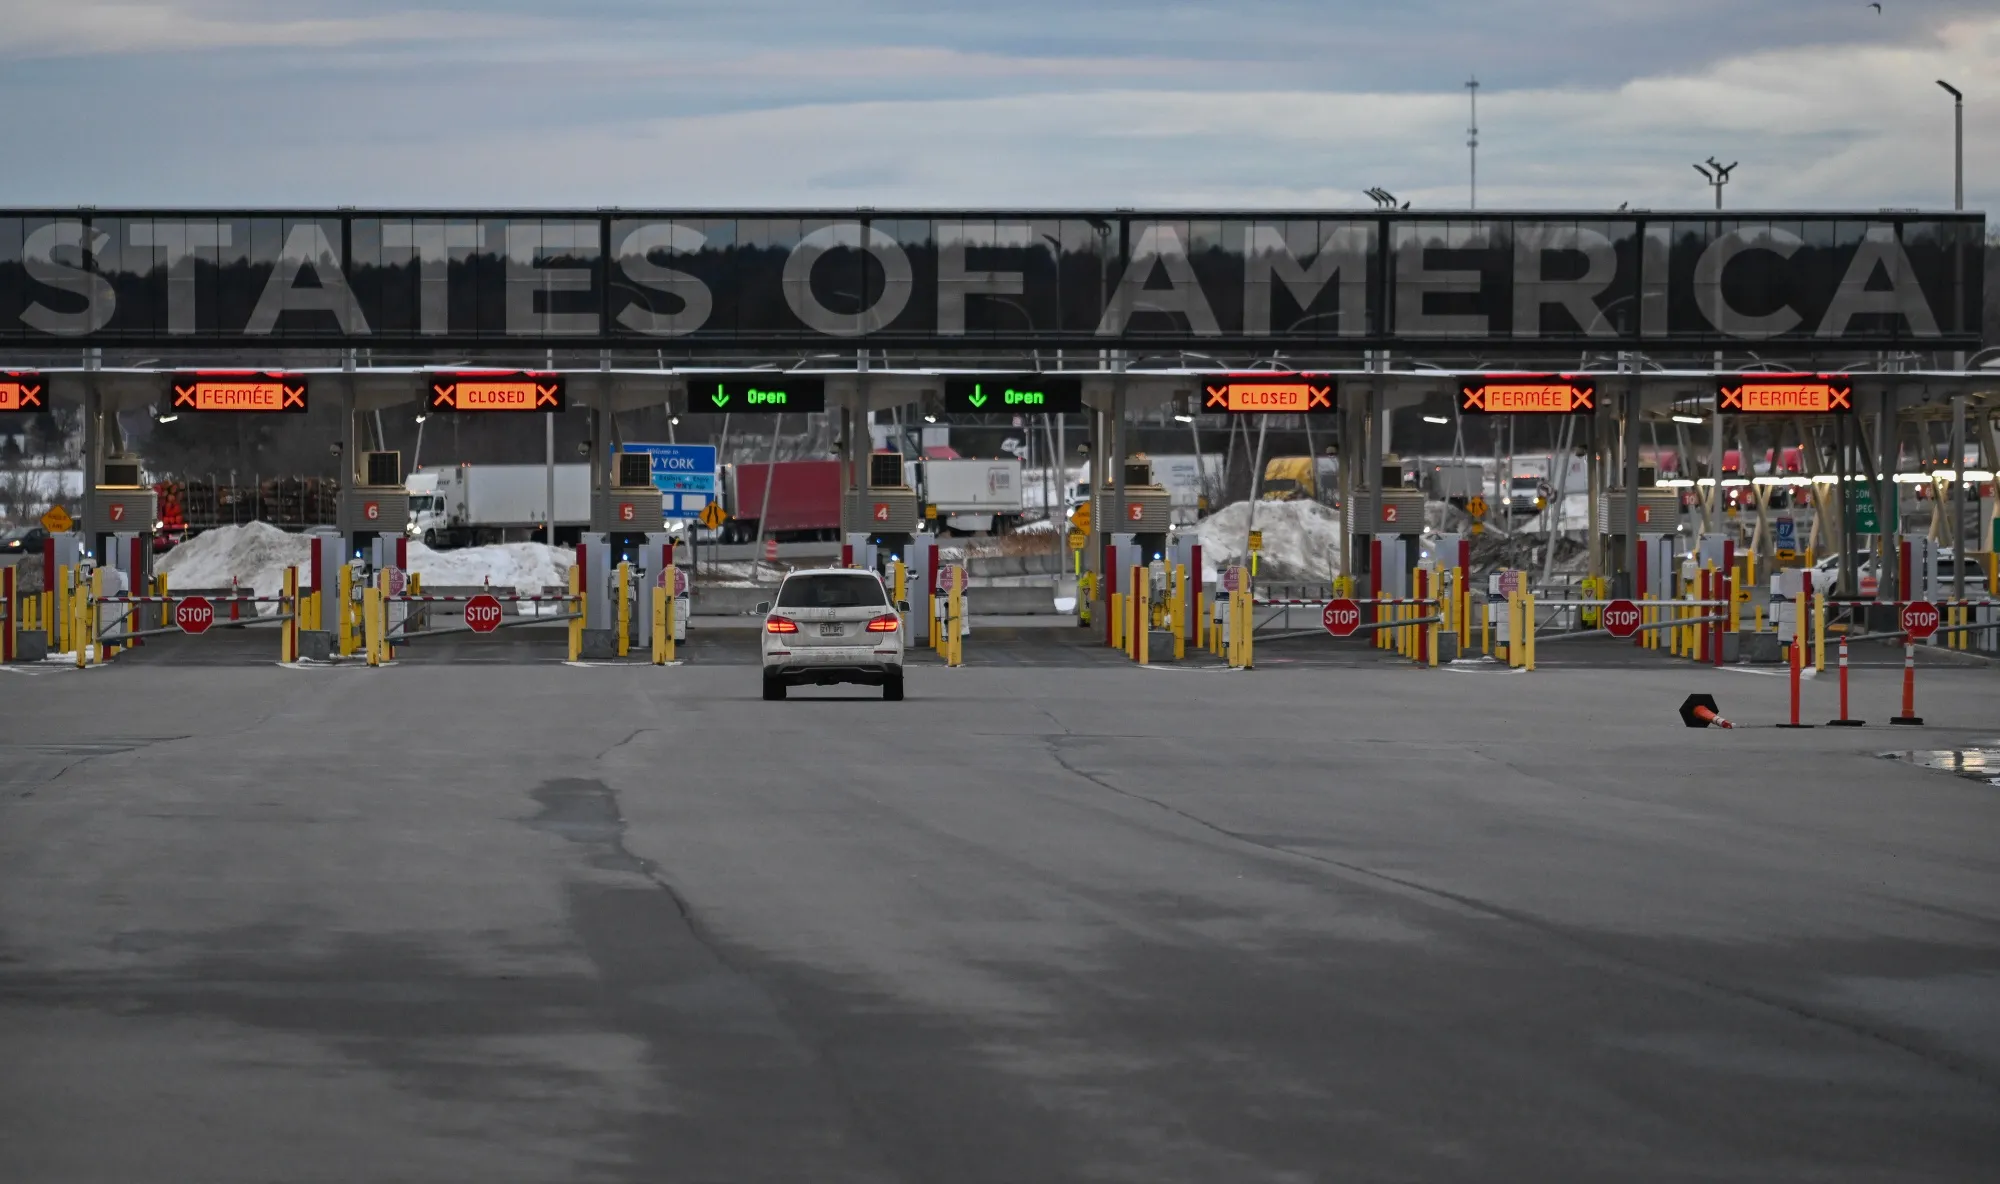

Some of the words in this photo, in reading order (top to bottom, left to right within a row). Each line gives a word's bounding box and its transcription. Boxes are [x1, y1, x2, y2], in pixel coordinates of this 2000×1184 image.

[19, 223, 713, 336] STATES
[782, 223, 1031, 337] OF
[1094, 225, 1942, 339] AMERICA
[202, 384, 274, 405] FERMÉE
[468, 390, 526, 404] CLOSED
[747, 389, 787, 405] Open
[1004, 390, 1044, 405] Open
[1240, 392, 1298, 405] CLOSED
[1491, 387, 1562, 407] FERMÉE
[1748, 386, 1820, 406] FERMÉE
[661, 457, 695, 469] YORK
[1686, 495, 1695, 504] 10
[113, 507, 123, 520] 7
[367, 506, 378, 519] 6
[624, 507, 633, 520] 5
[877, 507, 888, 520] 4
[1133, 508, 1142, 520] 3
[1386, 508, 1396, 522] 2
[1643, 509, 1650, 523] 1
[1780, 524, 1790, 537] 87
[178, 608, 211, 622] STOP
[467, 606, 499, 621] STOP
[1325, 610, 1357, 624] STOP
[1605, 611, 1638, 625] STOP
[1905, 612, 1937, 627] STOP
